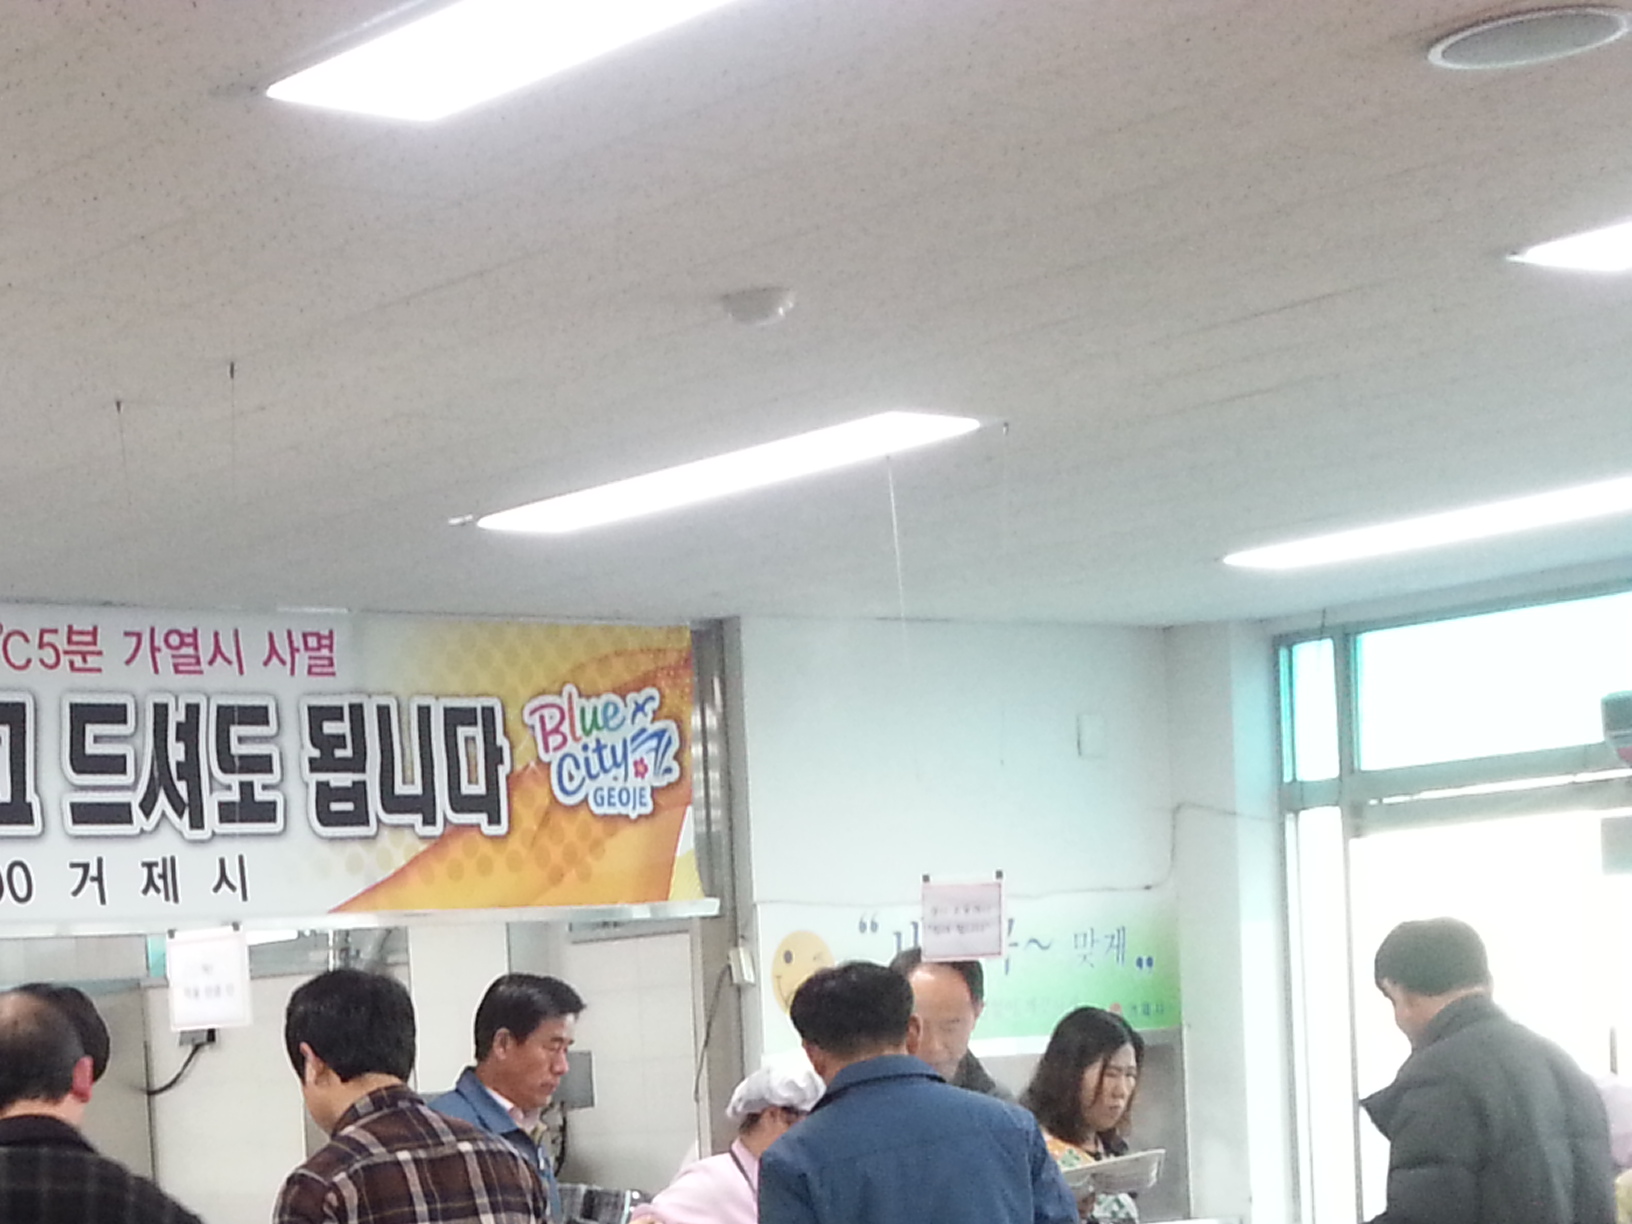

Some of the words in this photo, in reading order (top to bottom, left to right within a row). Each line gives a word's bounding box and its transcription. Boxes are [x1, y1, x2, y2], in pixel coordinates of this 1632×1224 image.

[122, 626, 245, 677] 가열시
[262, 628, 337, 678] 사멸
[528, 691, 626, 754] Blue
[66, 699, 279, 831] 드셔도
[305, 701, 505, 829] 됩니다
[592, 786, 648, 811] GEOJE
